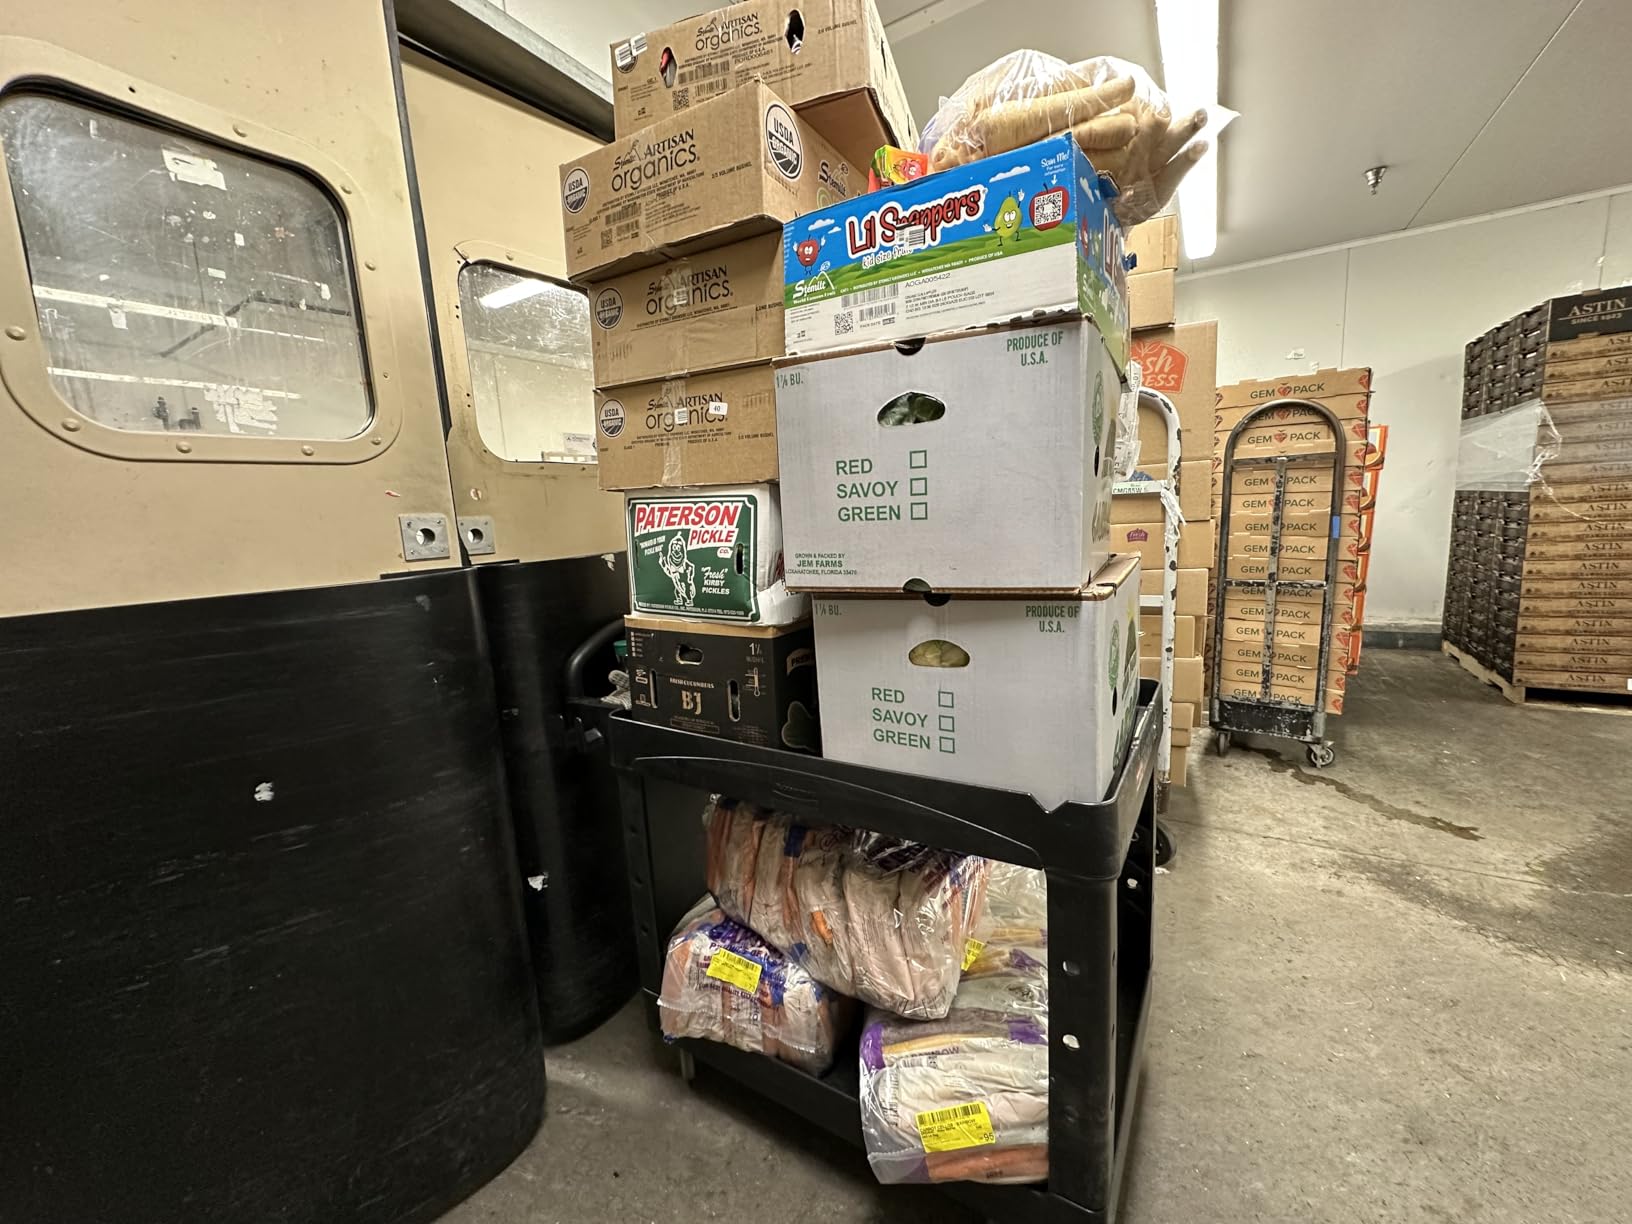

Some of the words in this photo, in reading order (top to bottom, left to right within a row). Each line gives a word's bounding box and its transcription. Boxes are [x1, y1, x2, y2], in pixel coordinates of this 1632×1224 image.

[721, 12, 758, 31] ARTISAN
[695, 22, 760, 51] organics
[774, 117, 795, 146] USDA
[644, 128, 695, 159] ARTISAN
[612, 144, 697, 192] organics
[568, 178, 584, 191] USDA
[848, 215, 877, 256] Lil
[862, 253, 875, 269] kid
[876, 250, 891, 264] size
[680, 264, 728, 288] ARTISAN
[793, 279, 827, 300] Stemilt
[646, 280, 730, 317] orgnics
[1568, 297, 1627, 317] ASTIN
[1571, 314, 1599, 326] SINCE
[1007, 332, 1049, 352] PRODUCE
[1051, 331, 1064, 346] OF
[1021, 351, 1049, 367] U.S.A.
[790, 371, 804, 386] BU.
[1250, 388, 1275, 400] GEM
[1293, 383, 1325, 394] PACK
[678, 392, 723, 408] ARTISAN
[605, 407, 619, 417] USDA
[1247, 435, 1272, 444] GEM
[1290, 432, 1321, 441] PACK
[836, 458, 873, 476] RED
[1244, 477, 1269, 486] GEM
[1286, 475, 1317, 485] PACK
[836, 481, 899, 499] SAVOY
[1588, 483, 1630, 493] ASTIN
[1242, 500, 1267, 508] GEM
[1284, 499, 1315, 507] PACK
[1586, 503, 1628, 511] ASTIN
[636, 505, 739, 532] PATERSON
[838, 505, 901, 522] GREEN
[1244, 523, 1269, 532] GEM
[1286, 522, 1317, 531] PACK
[1584, 522, 1625, 532] ASTIN
[690, 530, 735, 547] PICKLE
[1243, 544, 1268, 553] GEM
[1285, 545, 1316, 554] PACK
[1583, 542, 1623, 551] ASTIN
[797, 560, 813, 568] JEM
[815, 560, 843, 568] FARMS
[1240, 565, 1265, 574] GEM
[1281, 566, 1312, 575] PACK
[1579, 562, 1620, 571] ASTIN
[702, 587, 730, 595] PICKLES
[1242, 587, 1266, 595] GEM
[1282, 588, 1313, 598] PACK
[1577, 581, 1618, 590] ASTIN
[828, 604, 842, 616] BU.
[1026, 605, 1066, 618] PRODUCE
[1067, 605, 1080, 618] OF
[1576, 600, 1616, 609] ASTIN
[1240, 607, 1265, 616] GEM
[1281, 609, 1311, 619] PACK
[1039, 620, 1066, 633] U.S.A.
[1572, 619, 1613, 628] ASTIN
[1236, 627, 1260, 636] GEM
[1276, 630, 1306, 640] PACK
[1571, 638, 1610, 646] ASTIN
[1237, 649, 1261, 658] GEM
[1277, 652, 1308, 664] PACK
[1568, 656, 1608, 665] ASTIN
[1235, 668, 1260, 678] GEM
[1275, 673, 1305, 684] PACK
[1566, 674, 1606, 682] ASTIN
[682, 690, 702, 715] BJ
[871, 687, 905, 704] RED
[1233, 688, 1257, 698] GEM
[1273, 693, 1303, 703] PACK
[872, 708, 928, 728] SAVOY
[873, 729, 931, 750] GREEN
